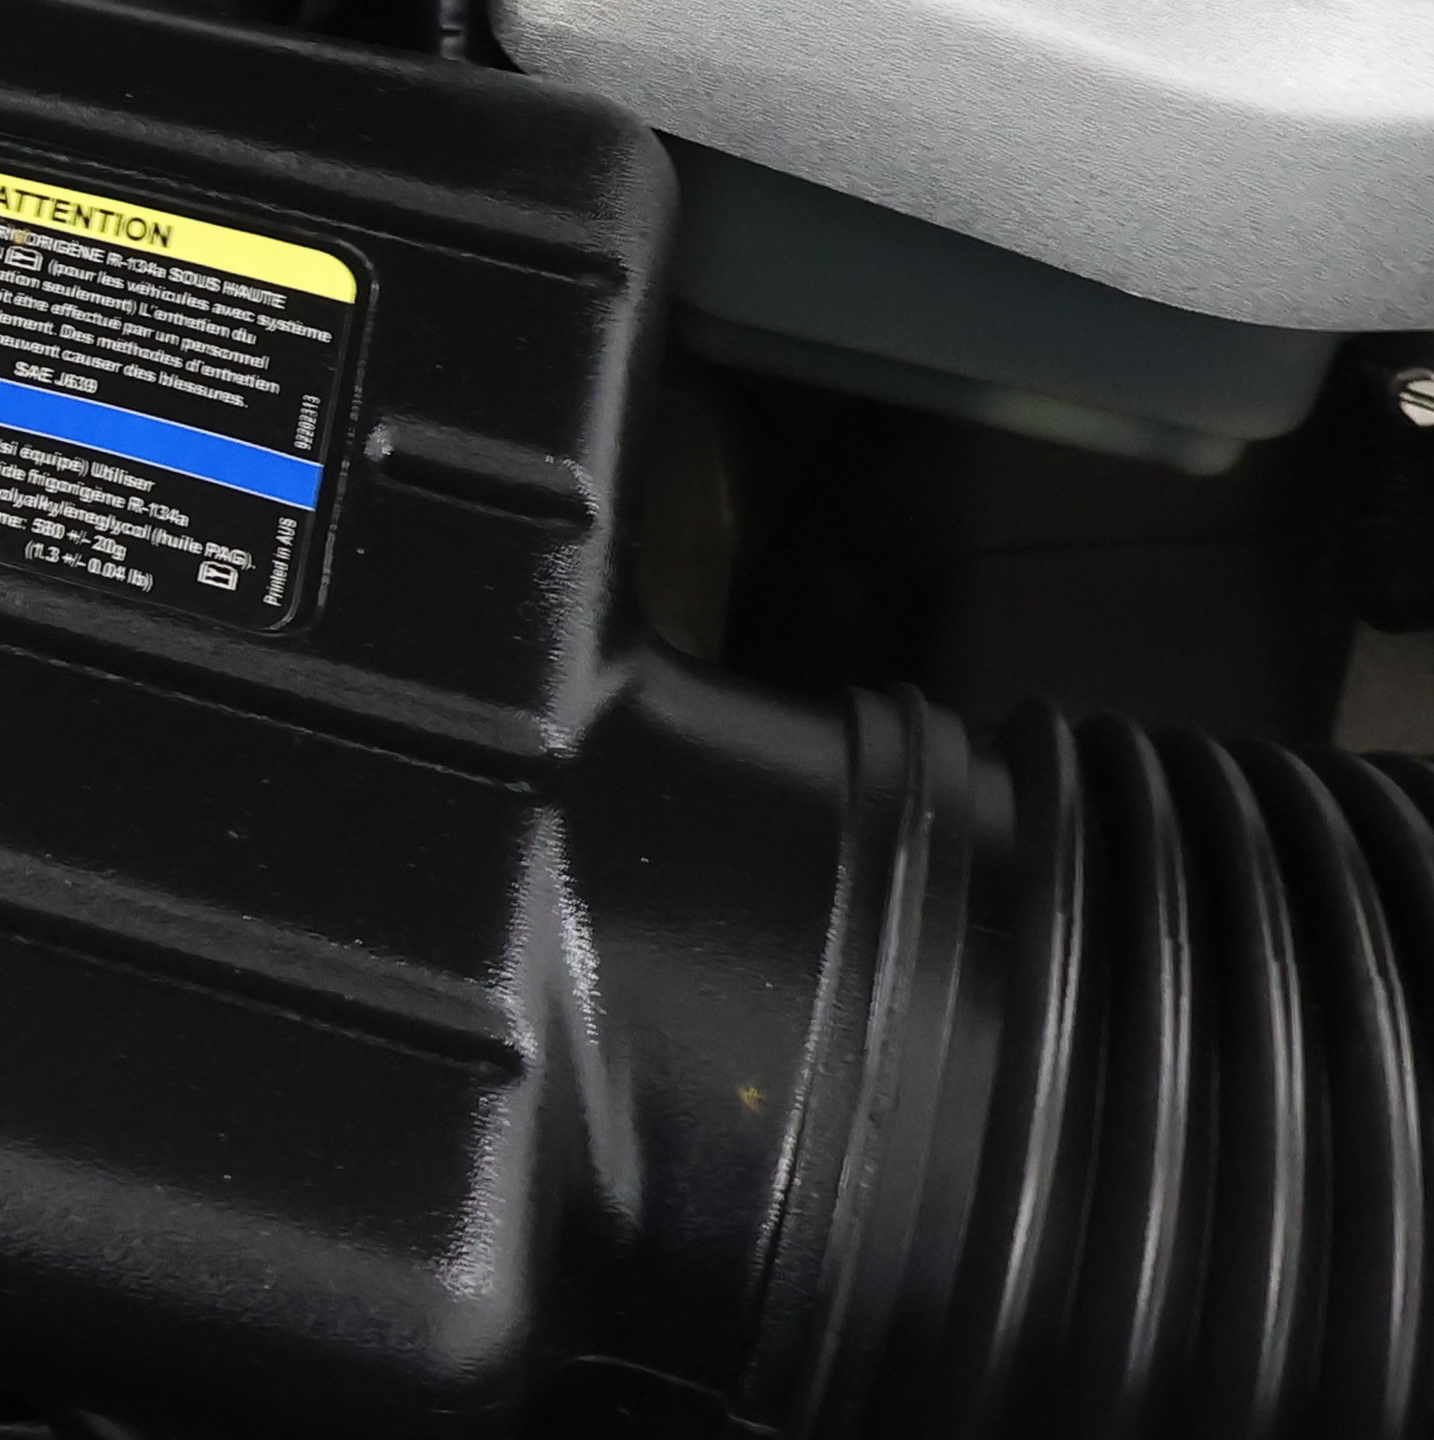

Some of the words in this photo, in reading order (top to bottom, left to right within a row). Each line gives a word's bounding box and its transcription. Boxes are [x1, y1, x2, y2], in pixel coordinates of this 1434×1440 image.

[106, 252, 166, 278] R-134a
[168, 267, 221, 292] SOUS
[222, 281, 286, 309] HAUTE
[97, 270, 124, 288] les
[127, 281, 209, 310] véhicules
[211, 303, 255, 322] avec
[256, 314, 332, 342] système
[13, 292, 49, 311] être
[121, 322, 154, 337] par
[155, 331, 179, 345] un
[180, 338, 269, 369] personnel
[231, 327, 256, 344] du
[59, 324, 94, 344] Des
[96, 337, 183, 368] méthodes
[13, 361, 54, 383] SAE
[61, 349, 123, 372] causer
[123, 363, 156, 382] des
[158, 371, 247, 407] blessures.
[90, 461, 155, 492] Utiliser
[127, 496, 189, 526] R-134a
[151, 528, 203, 554] (huile
[276, 517, 296, 545] AUS
[91, 535, 126, 561] 20g
[276, 547, 290, 559] in
[263, 560, 288, 606] Printed
